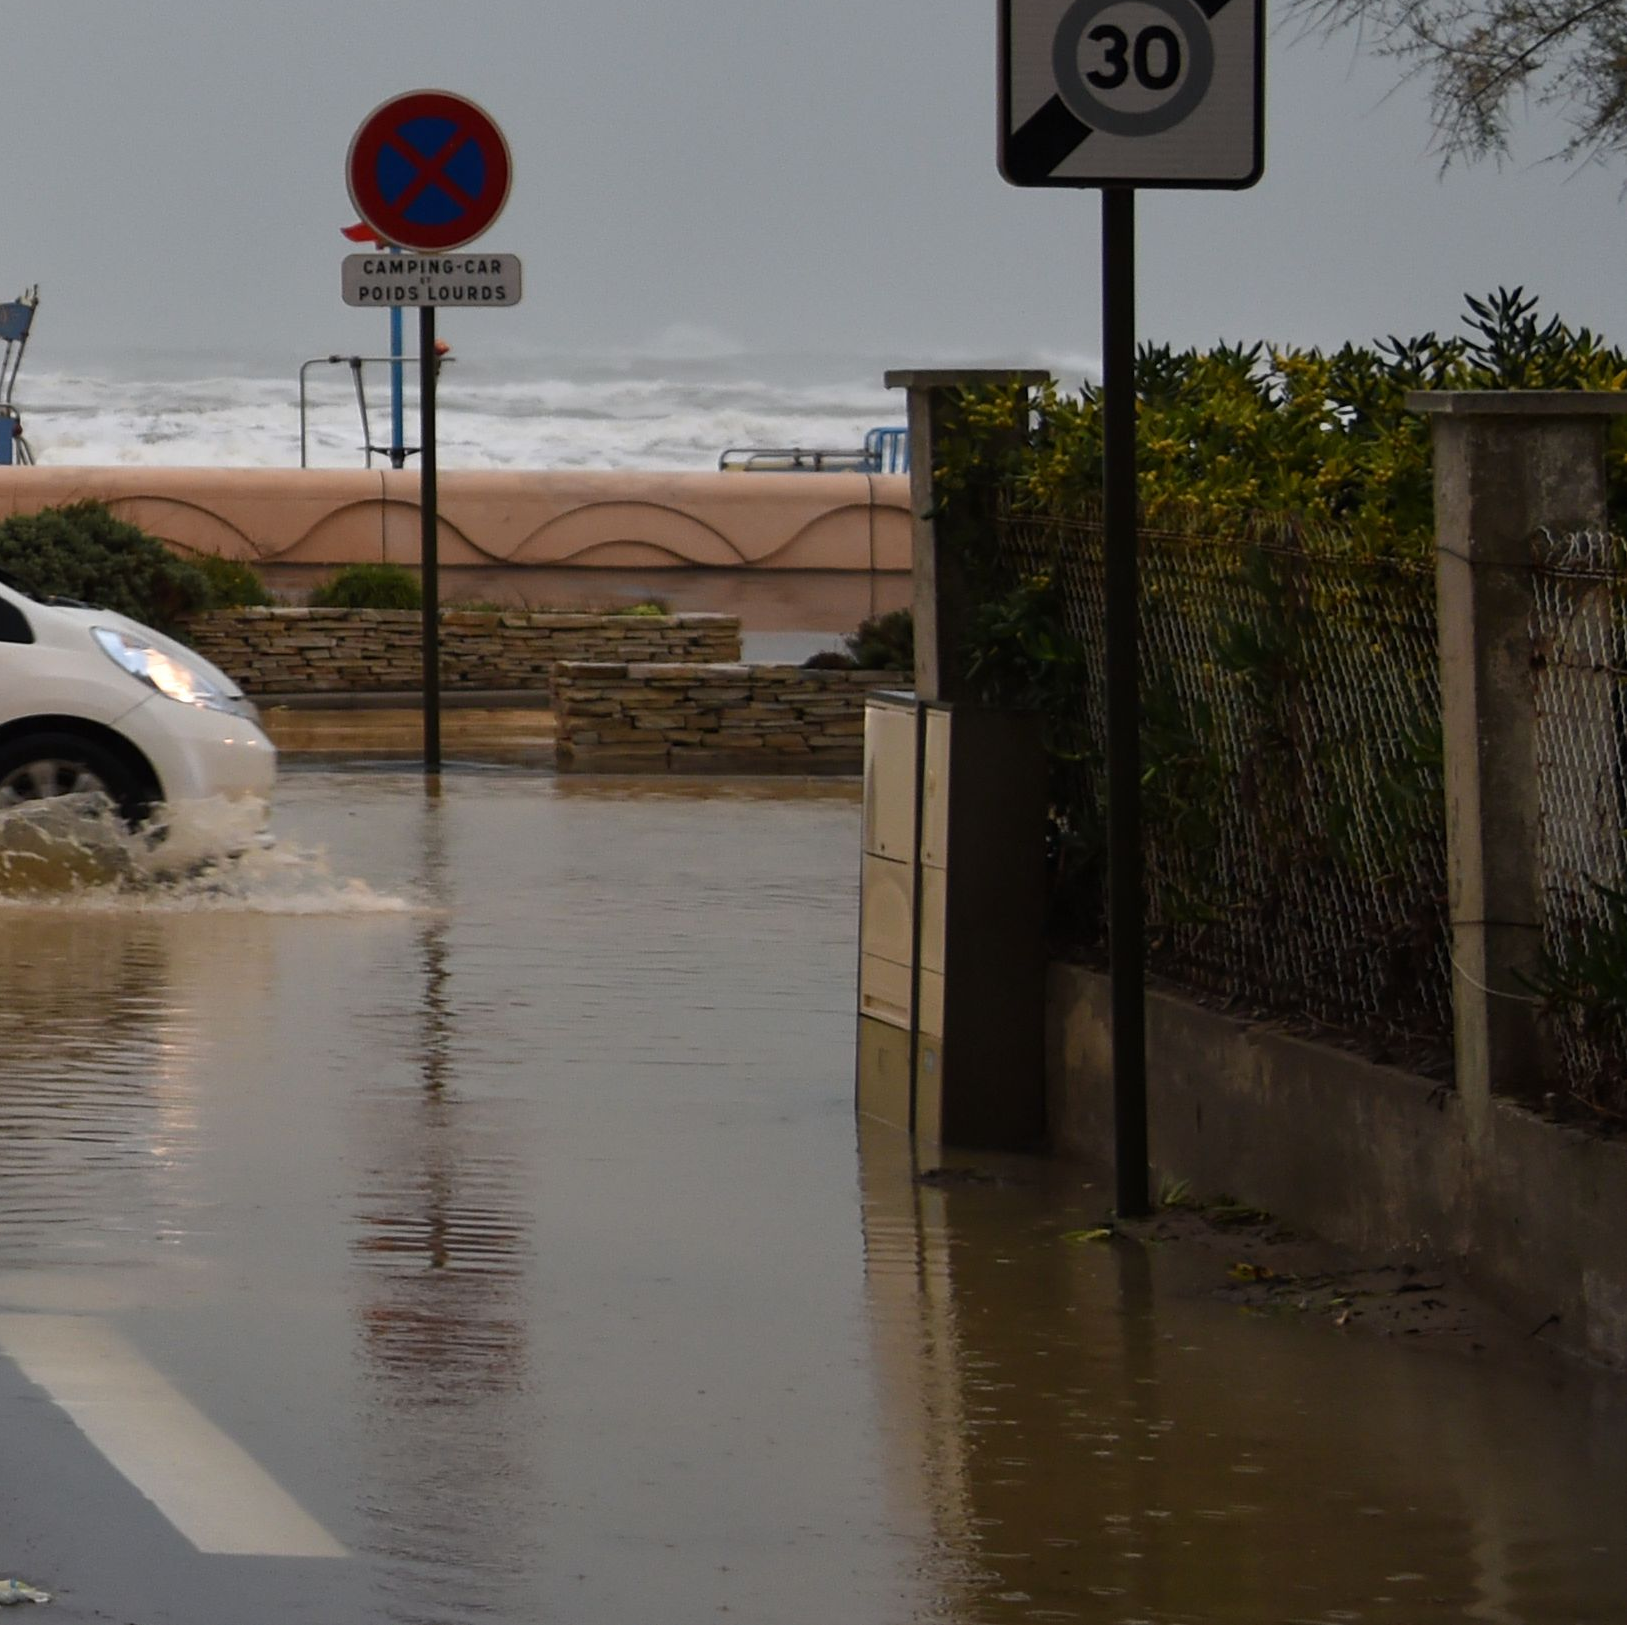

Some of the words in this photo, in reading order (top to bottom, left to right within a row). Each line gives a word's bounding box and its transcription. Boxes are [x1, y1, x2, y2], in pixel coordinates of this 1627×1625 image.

[1085, 23, 1182, 91] 30
[363, 259, 502, 275] CAMPING-CAR
[359, 286, 419, 301] POIDS
[428, 285, 506, 301] LOURDS
